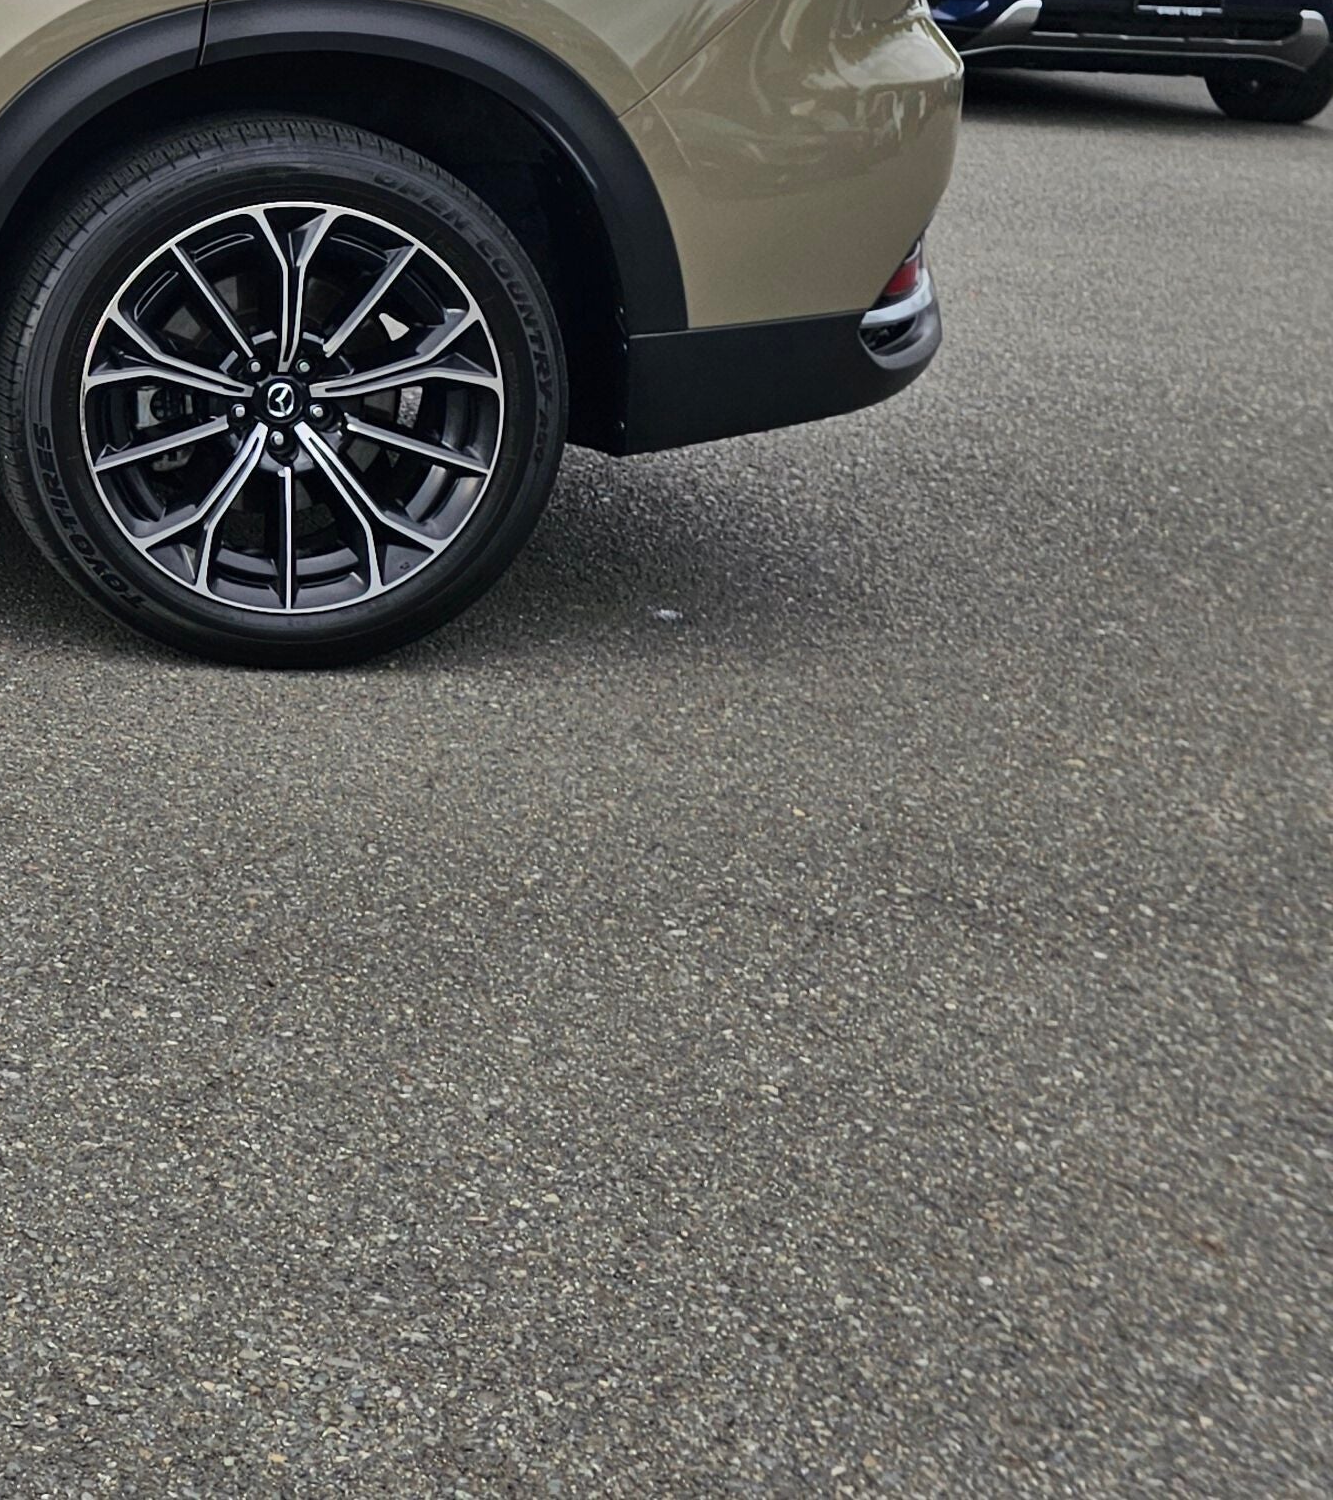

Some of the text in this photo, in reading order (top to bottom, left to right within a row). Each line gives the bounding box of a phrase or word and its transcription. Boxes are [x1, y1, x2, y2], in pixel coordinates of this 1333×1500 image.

[476, 239, 553, 404] COUNTRY
[33, 423, 145, 609] TOYO TIRES
